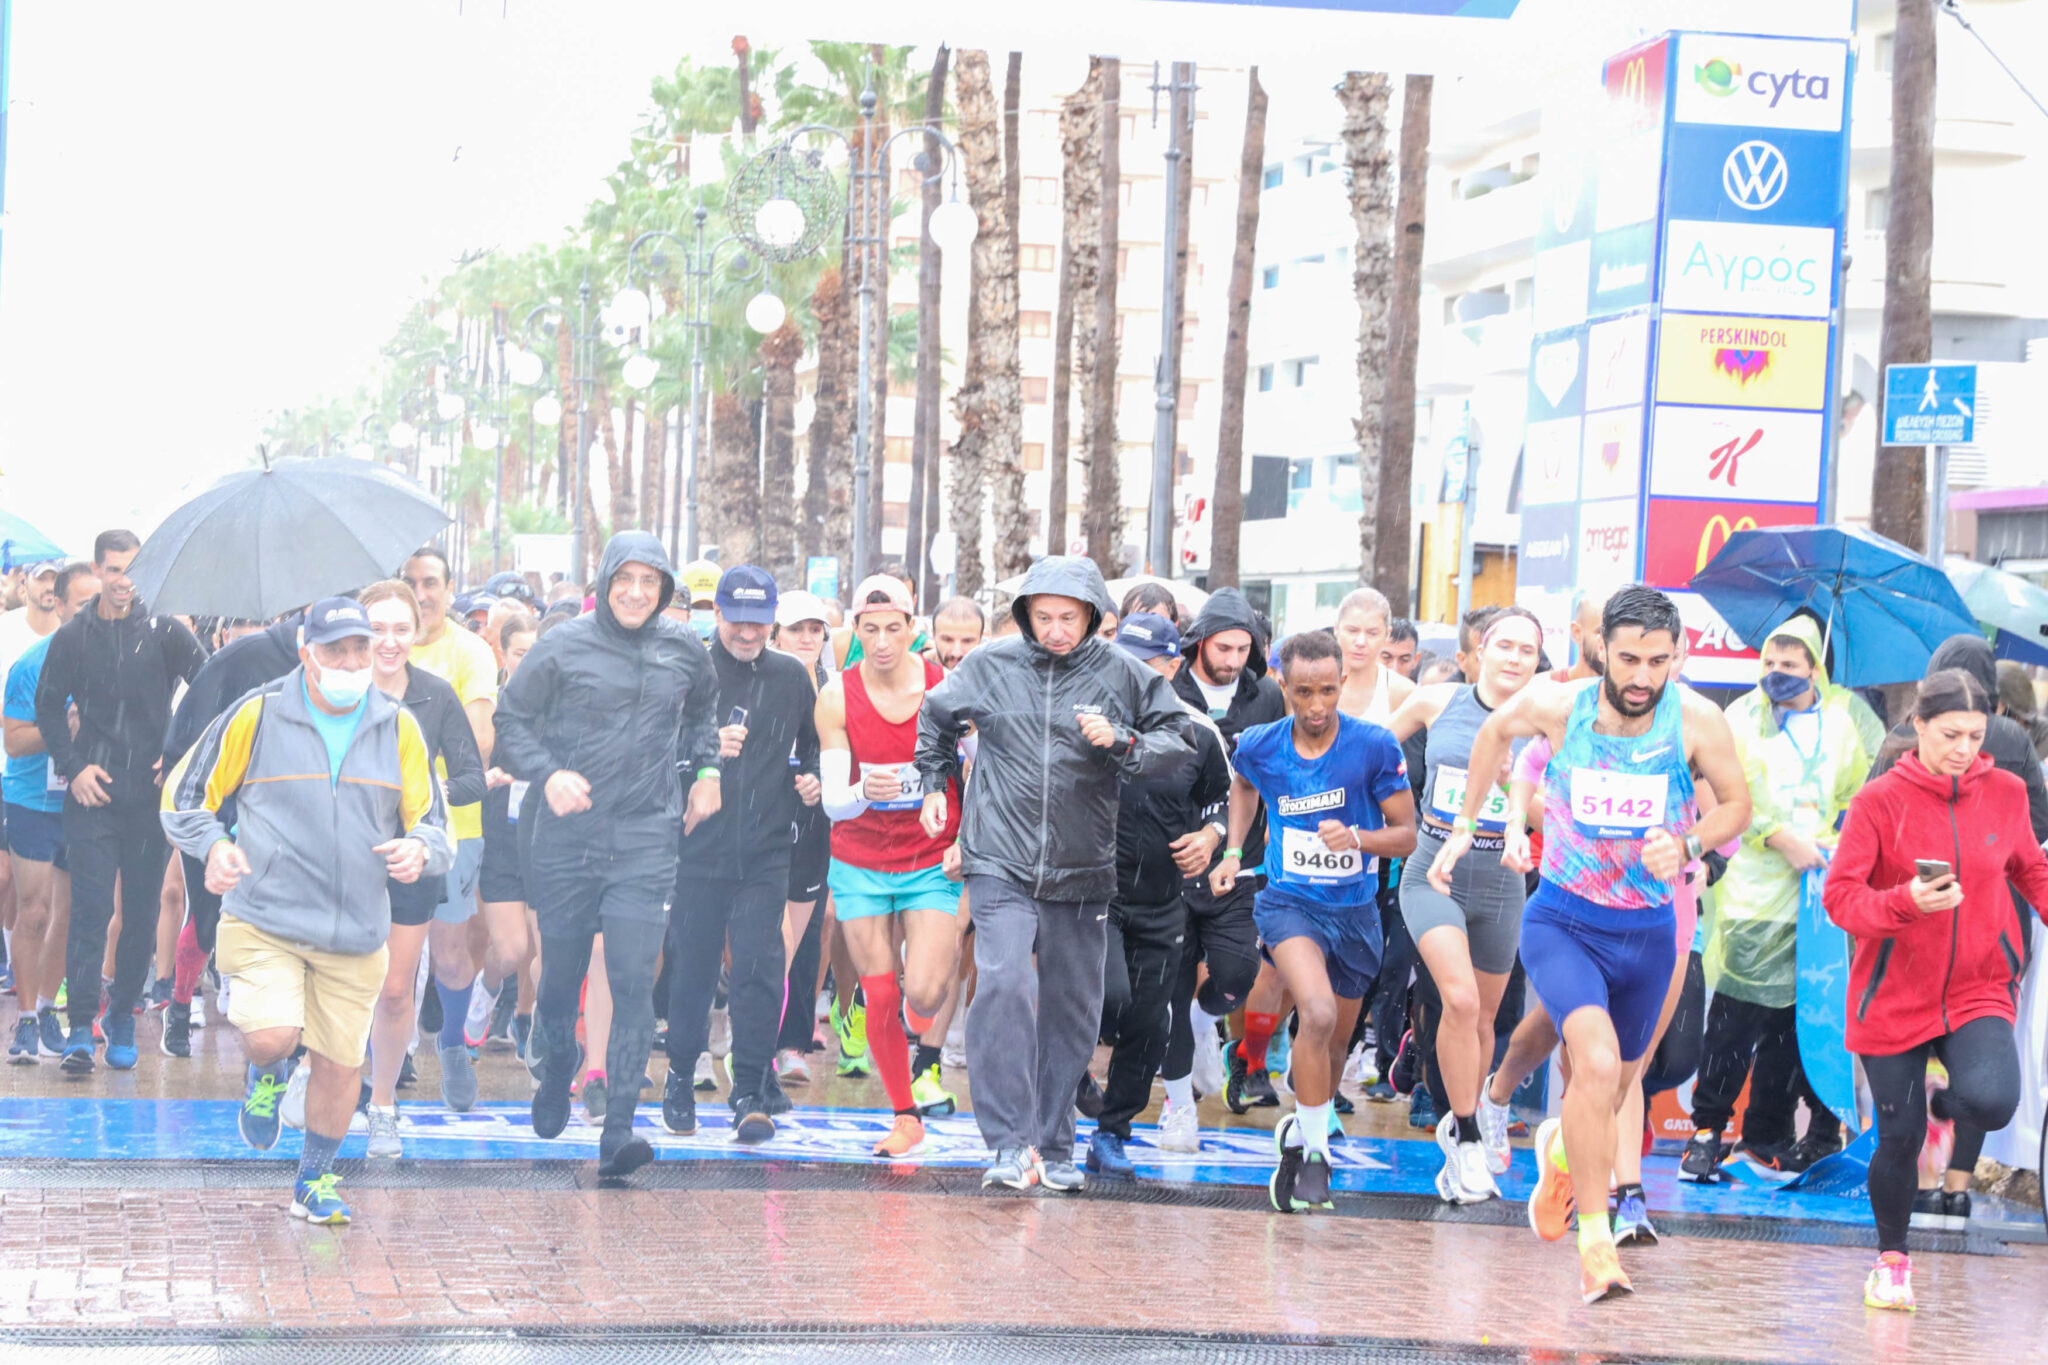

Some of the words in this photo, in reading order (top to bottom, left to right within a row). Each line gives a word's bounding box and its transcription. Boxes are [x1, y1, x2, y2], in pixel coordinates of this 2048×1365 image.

[1747, 68, 1830, 107] cyta
[1682, 241, 1817, 296] Αγρός
[1701, 328, 1787, 348] PERSKINDOL
[1582, 795, 1653, 817] 5142
[1472, 838, 1504, 849] NIKE
[1293, 851, 1354, 869] 9460
